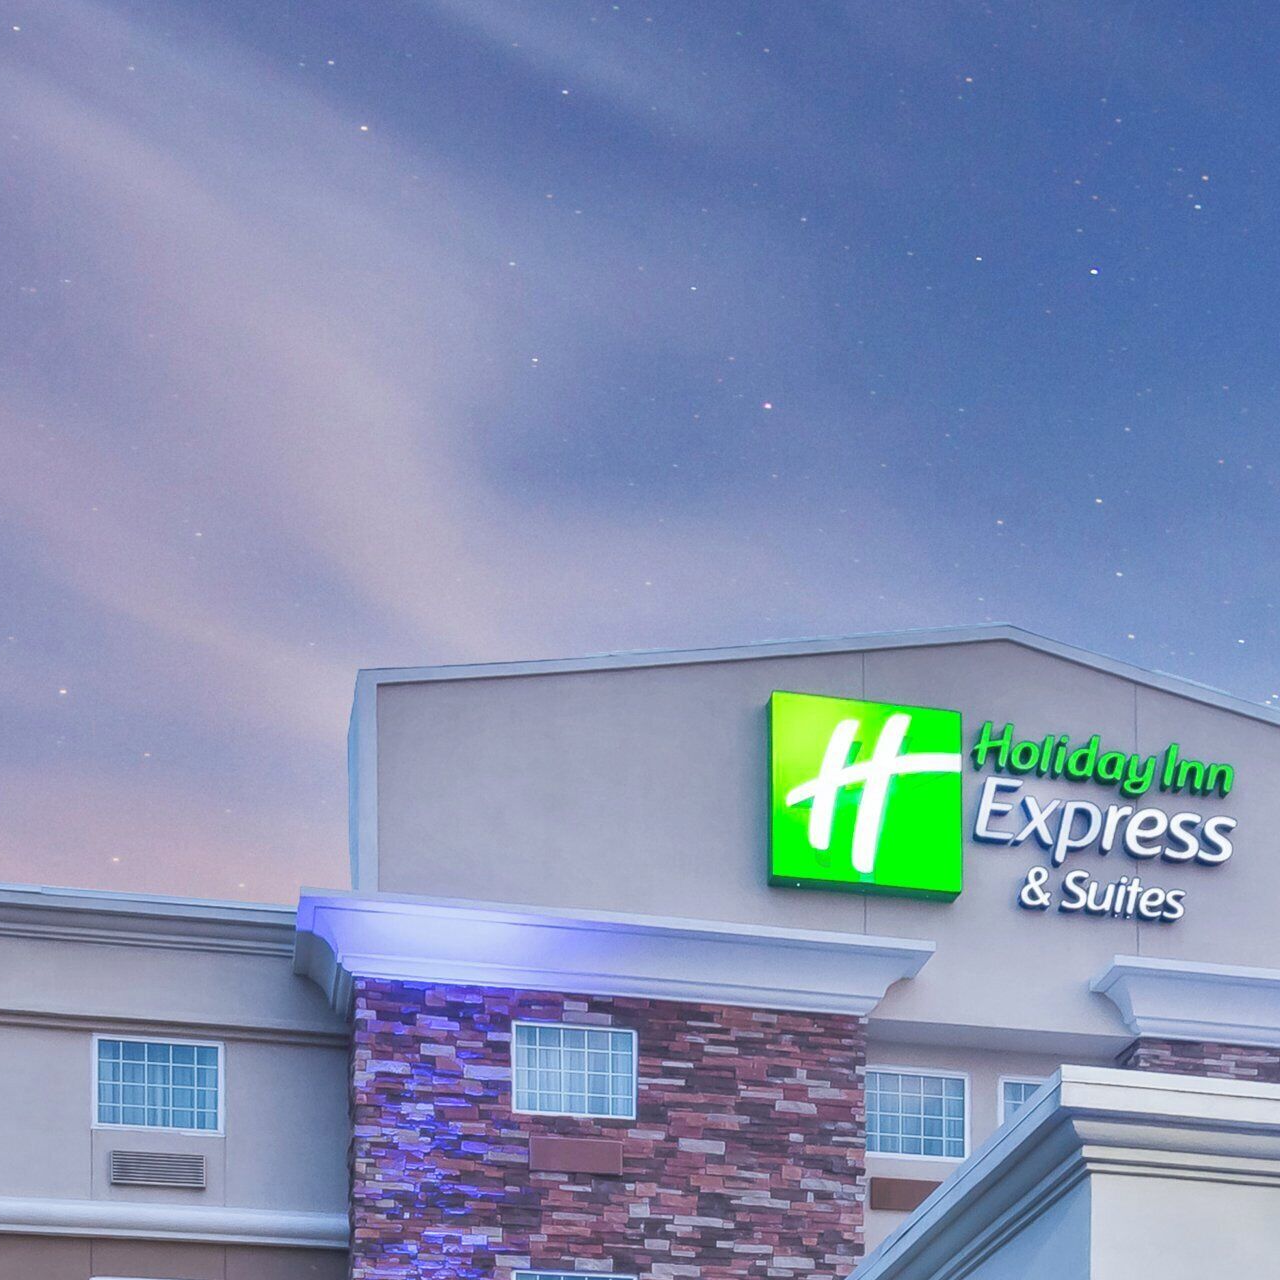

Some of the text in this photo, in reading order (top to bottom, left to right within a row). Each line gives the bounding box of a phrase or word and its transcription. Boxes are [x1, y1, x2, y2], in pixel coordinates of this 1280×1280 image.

[972, 720, 1235, 798] Holiday Inn
[974, 775, 1238, 867] Express
[1019, 866, 1187, 922] & Suites
